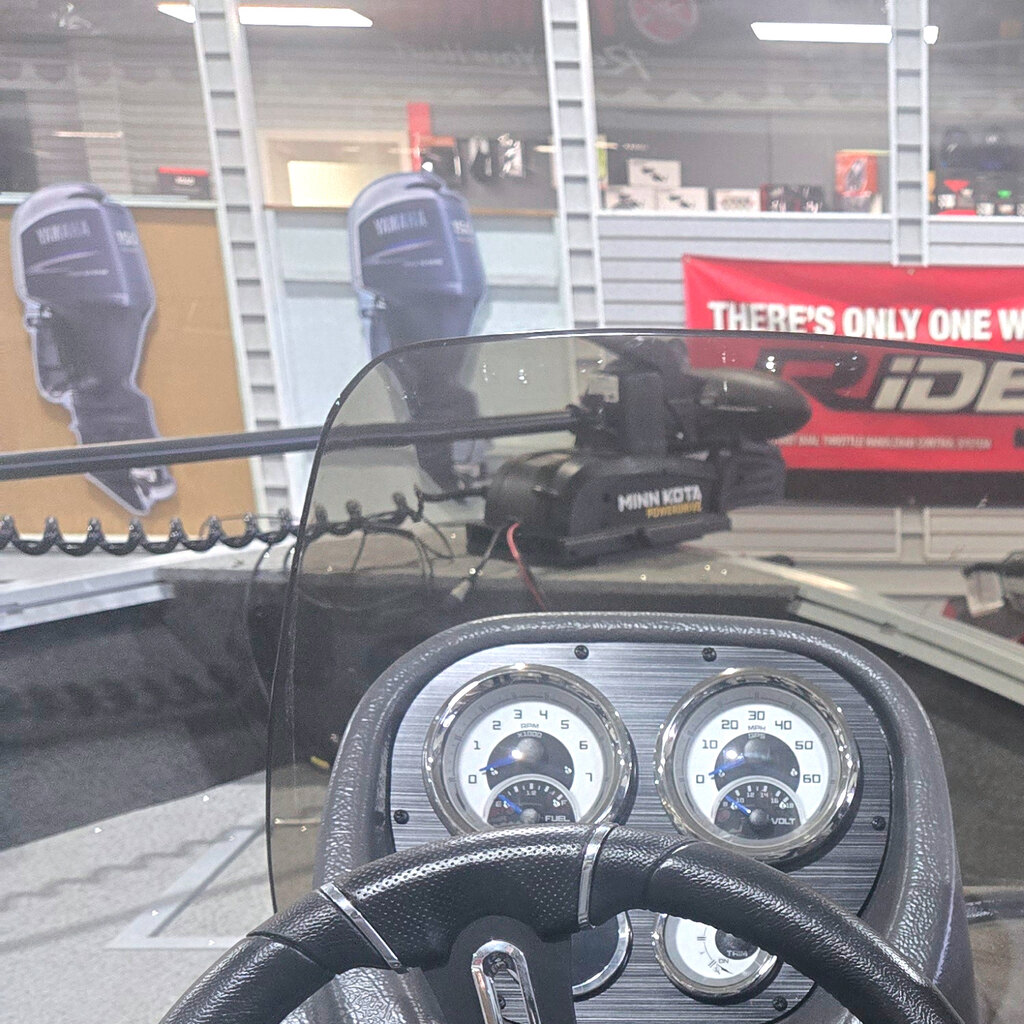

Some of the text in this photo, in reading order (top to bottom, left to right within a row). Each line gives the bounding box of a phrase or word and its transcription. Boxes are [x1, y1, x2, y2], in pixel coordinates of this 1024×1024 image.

[707, 300, 836, 335] THERE'S
[842, 306, 921, 340] ONLY
[928, 307, 993, 341] ONE
[617, 484, 702, 512] MINN KOTA
[513, 709, 522, 719] 3
[539, 710, 549, 719] 4
[748, 711, 765, 720] 30
[492, 720, 501, 730] 2
[560, 720, 570, 730] 5
[721, 720, 738, 729] 20
[775, 720, 792, 730] 40
[474, 741, 481, 750] 1
[579, 741, 588, 750] 6
[702, 740, 718, 749] 10
[795, 741, 813, 750] 50
[468, 775, 477, 784] 0
[585, 772, 593, 782] 7
[696, 775, 705, 784] 0
[803, 774, 821, 783] 60
